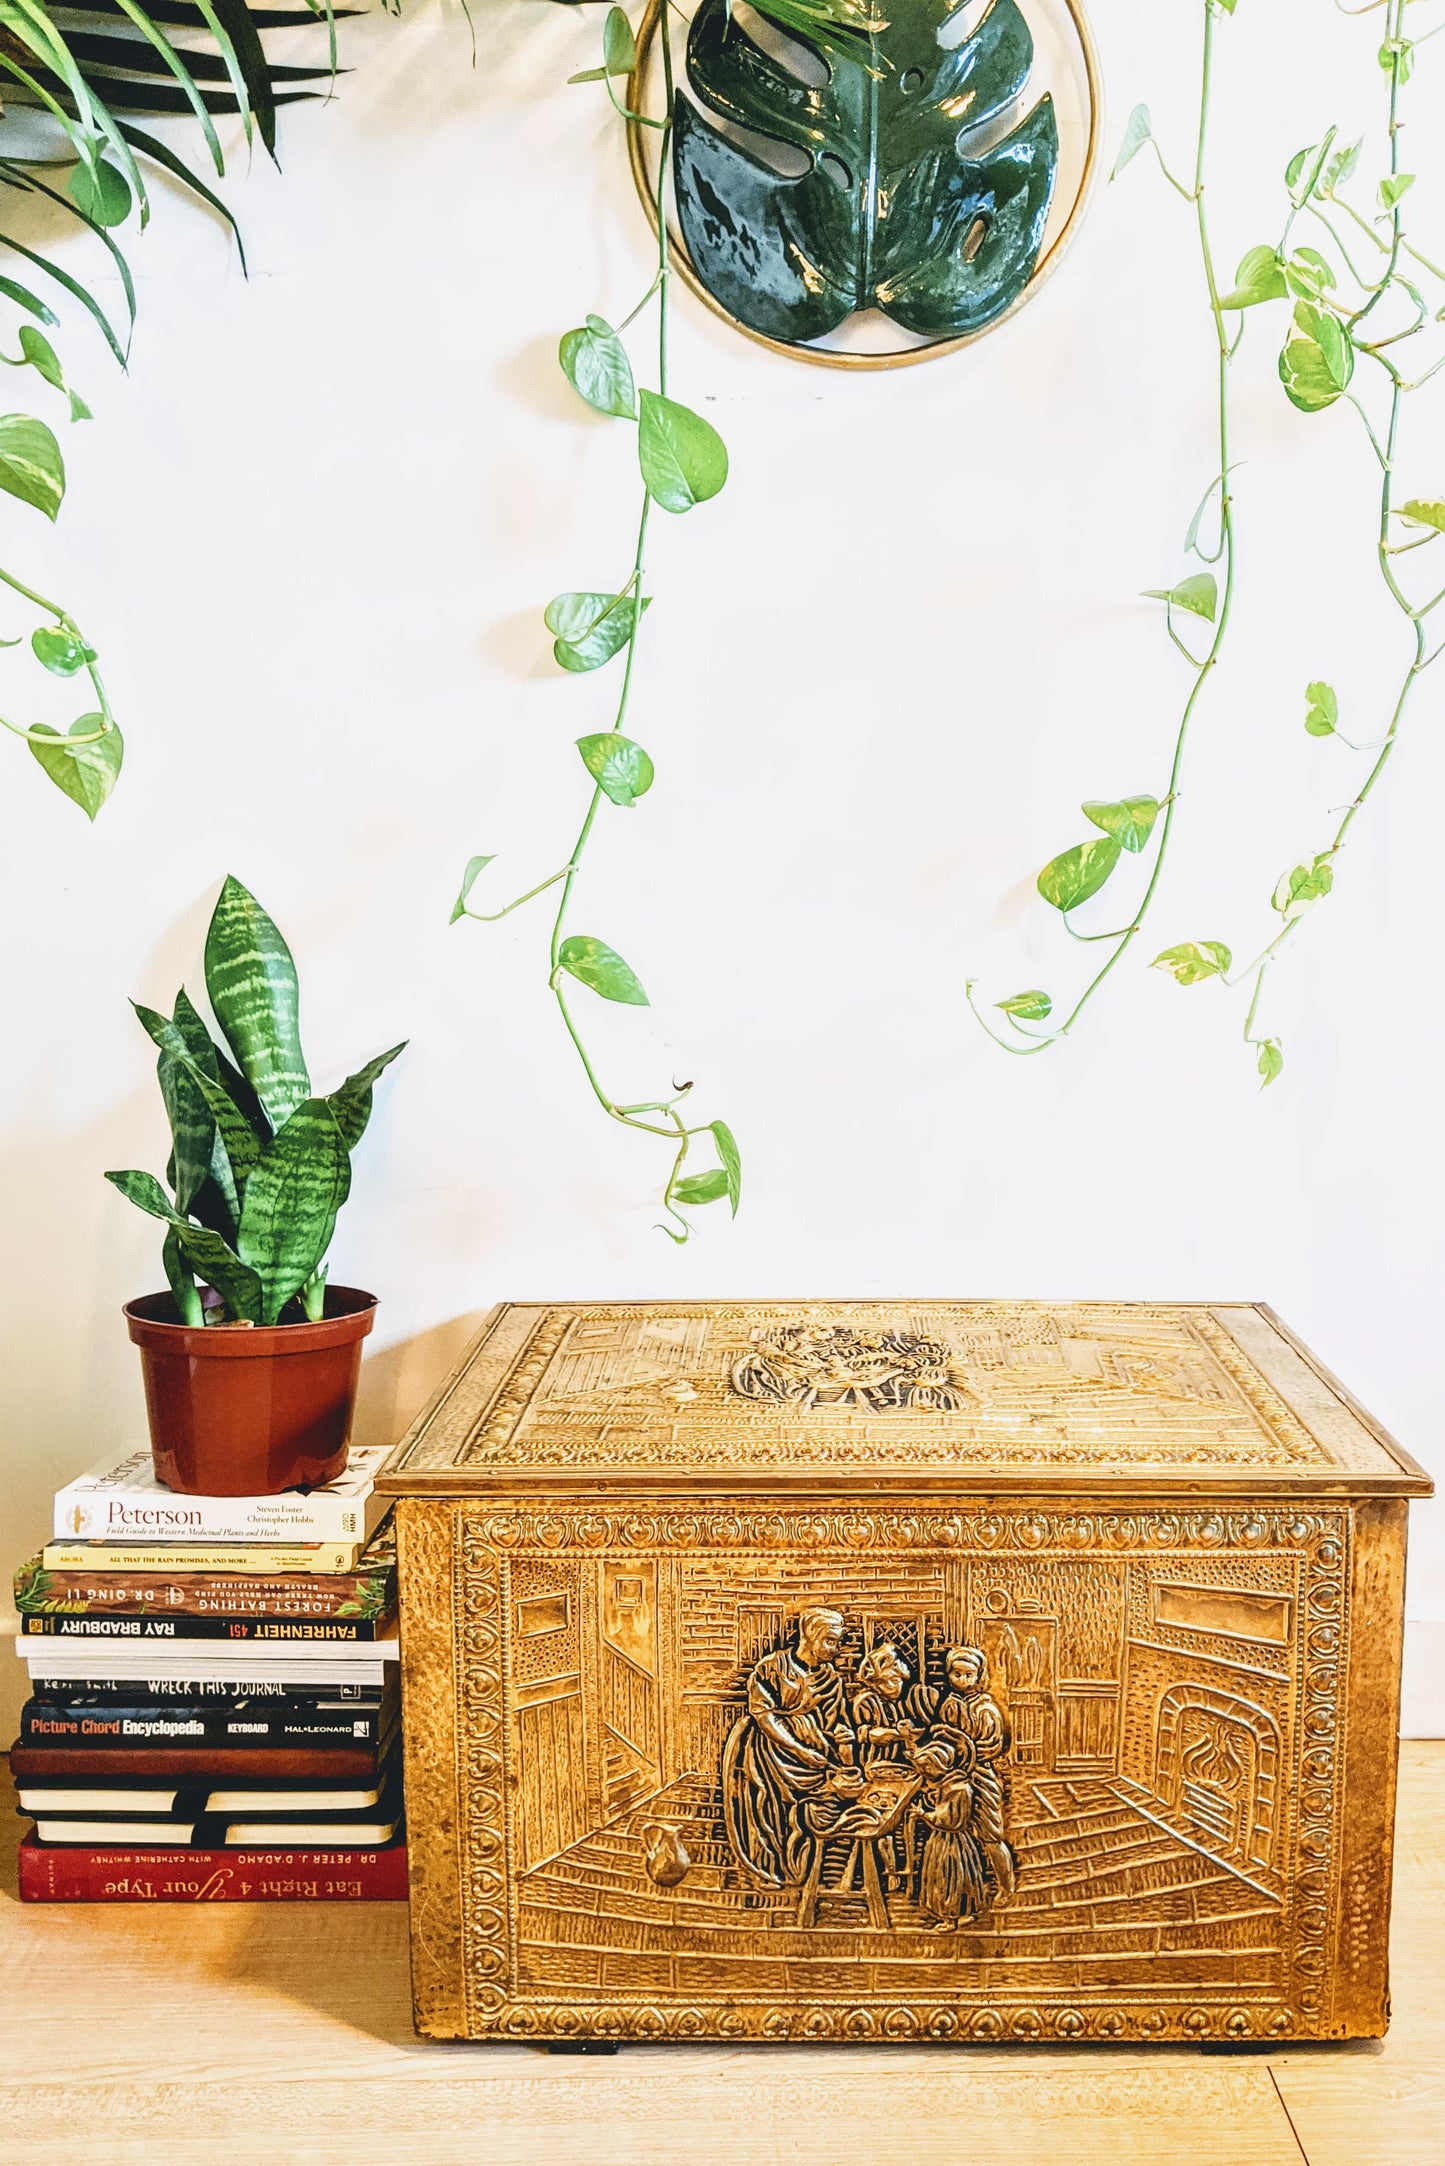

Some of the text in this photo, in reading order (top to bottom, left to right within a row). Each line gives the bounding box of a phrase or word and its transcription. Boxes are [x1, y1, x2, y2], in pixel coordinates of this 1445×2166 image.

[108, 1501, 202, 1525] Peterson
[256, 1505, 303, 1513] Steven Foster
[246, 1514, 314, 1525] Christopher Hobbs
[106, 1526, 125, 1535] Field
[126, 1527, 148, 1535] Guide
[158, 1527, 186, 1536] Western
[188, 1527, 221, 1536] Medicinal
[223, 1528, 244, 1537] Plants
[245, 1528, 259, 1537] and
[260, 1528, 280, 1537] Herbs
[67, 1588, 80, 1599] LI
[87, 1588, 126, 1600] QING
[130, 1589, 155, 1600] DR.
[199, 1600, 331, 1612] FOREST BATHING
[60, 1620, 141, 1634] BRADBURY
[144, 1622, 174, 1635] RAY
[229, 1623, 357, 1639] FAHRENHEIT 451
[86, 1680, 118, 1691] Smith
[147, 1680, 287, 1697] WRECK THIS JOURNAL
[31, 1719, 205, 1737] Picture Chord Encyclopedia
[227, 1723, 269, 1733] KEYBOARD
[90, 1855, 212, 1864] WITH CATHERINE WHITNEY
[238, 1854, 377, 1864] DR. PETER J. D'ADAMO
[105, 1868, 363, 1900] Eat Right 4 Your Type
